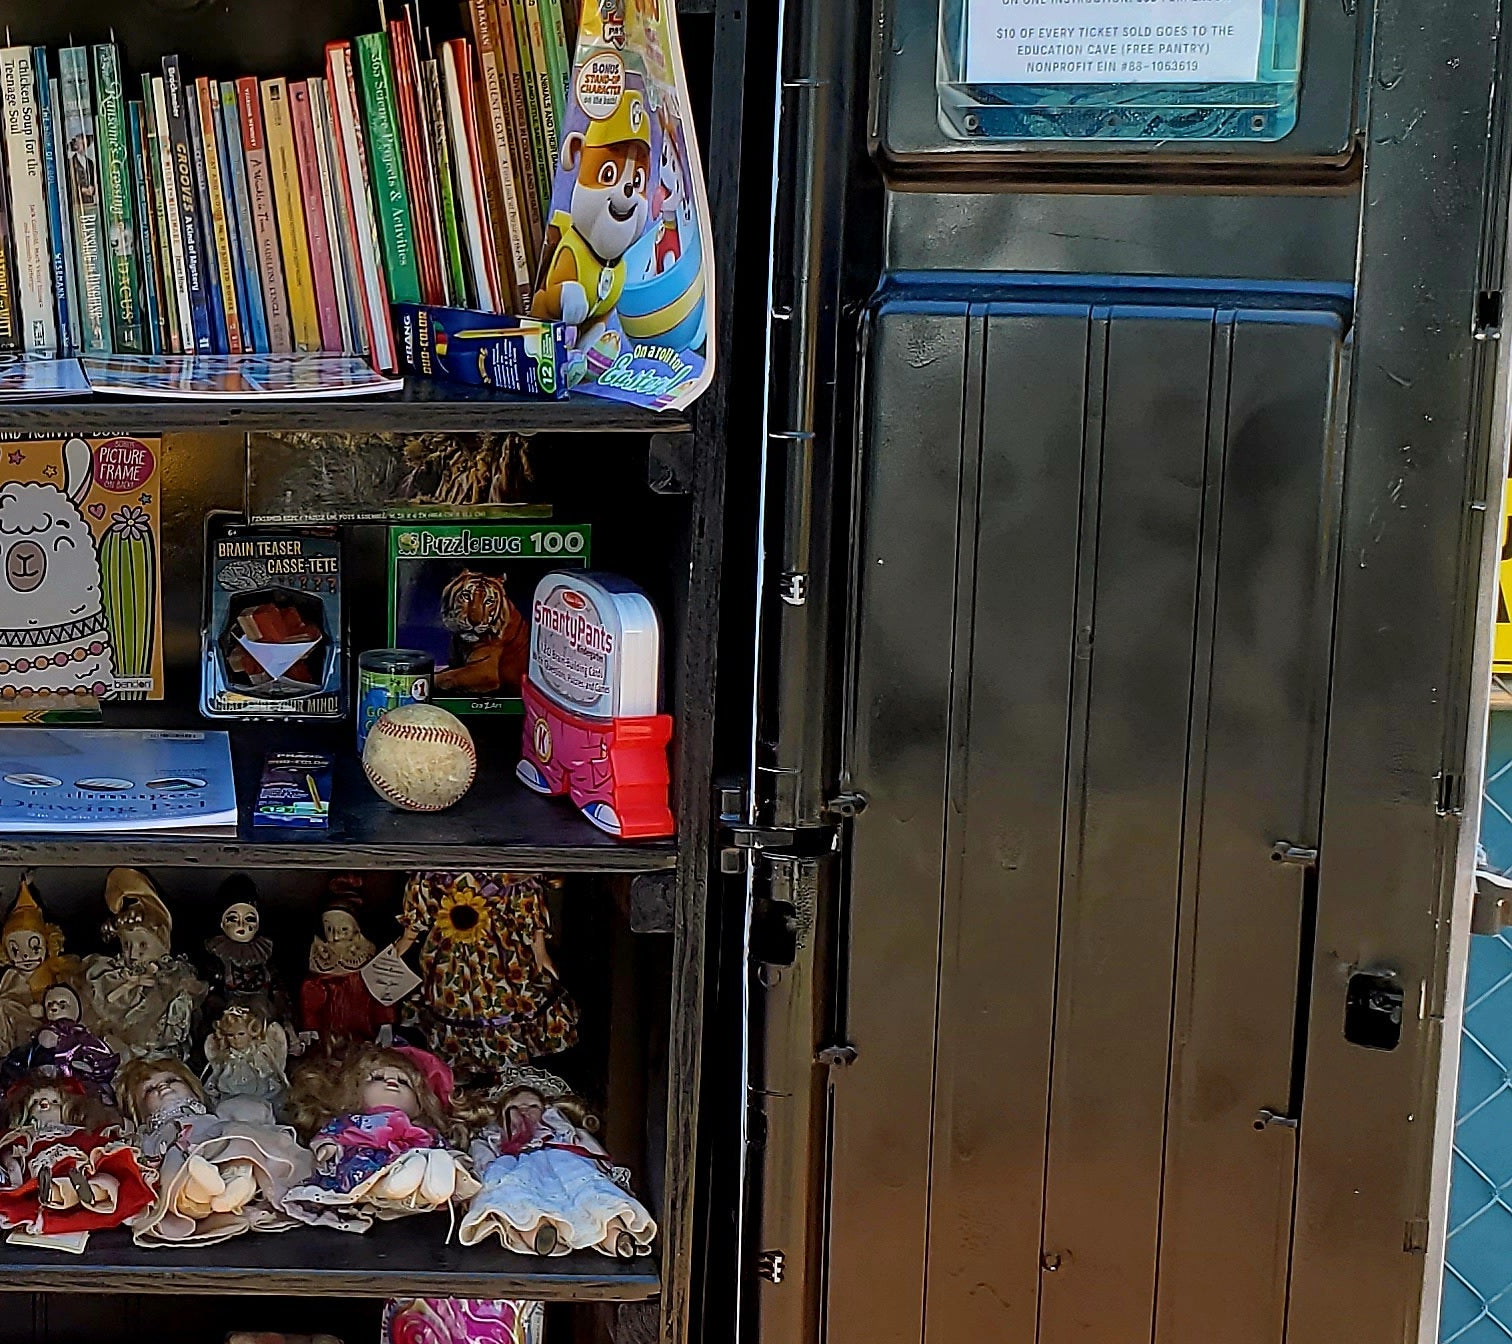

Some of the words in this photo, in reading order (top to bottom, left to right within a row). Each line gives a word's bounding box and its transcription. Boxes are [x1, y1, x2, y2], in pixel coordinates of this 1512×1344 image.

[996, 26, 1016, 39] $10
[1020, 27, 1035, 38] OF
[1038, 26, 1075, 39] EVERY
[1078, 26, 1119, 38] TICKET
[1122, 26, 1152, 37] SOLD
[1156, 25, 1188, 37] GOES
[1191, 25, 1207, 37] TO
[1211, 25, 1234, 36] THE
[1017, 44, 1083, 56] EDUCATION
[1087, 44, 1117, 55] CAVE
[1121, 43, 1155, 56] (FREE
[1158, 42, 1210, 55] PANTRY)
[1026, 61, 1093, 73] NONPROFIT
[1097, 61, 1117, 72] EIN
[4, 60, 18, 107] Teenage
[18, 59, 33, 105] Chicken
[10, 110, 19, 136] Soul
[22, 107, 34, 136] Soup
[26, 138, 35, 154] for
[28, 157, 37, 177] the
[176, 143, 193, 212] GROOVES
[388, 190, 399, 203] &
[186, 224, 194, 245] Kind
[391, 207, 409, 267] Activities
[189, 255, 200, 292] Mystery
[541, 365, 553, 385] 12
[99, 447, 146, 465] PICTURE
[99, 464, 142, 482] FRAME
[218, 542, 254, 557] BRAIN
[257, 541, 301, 556] TEASER
[530, 531, 585, 553] 100
[534, 599, 614, 655] SmartyPants
[538, 725, 547, 754] K
